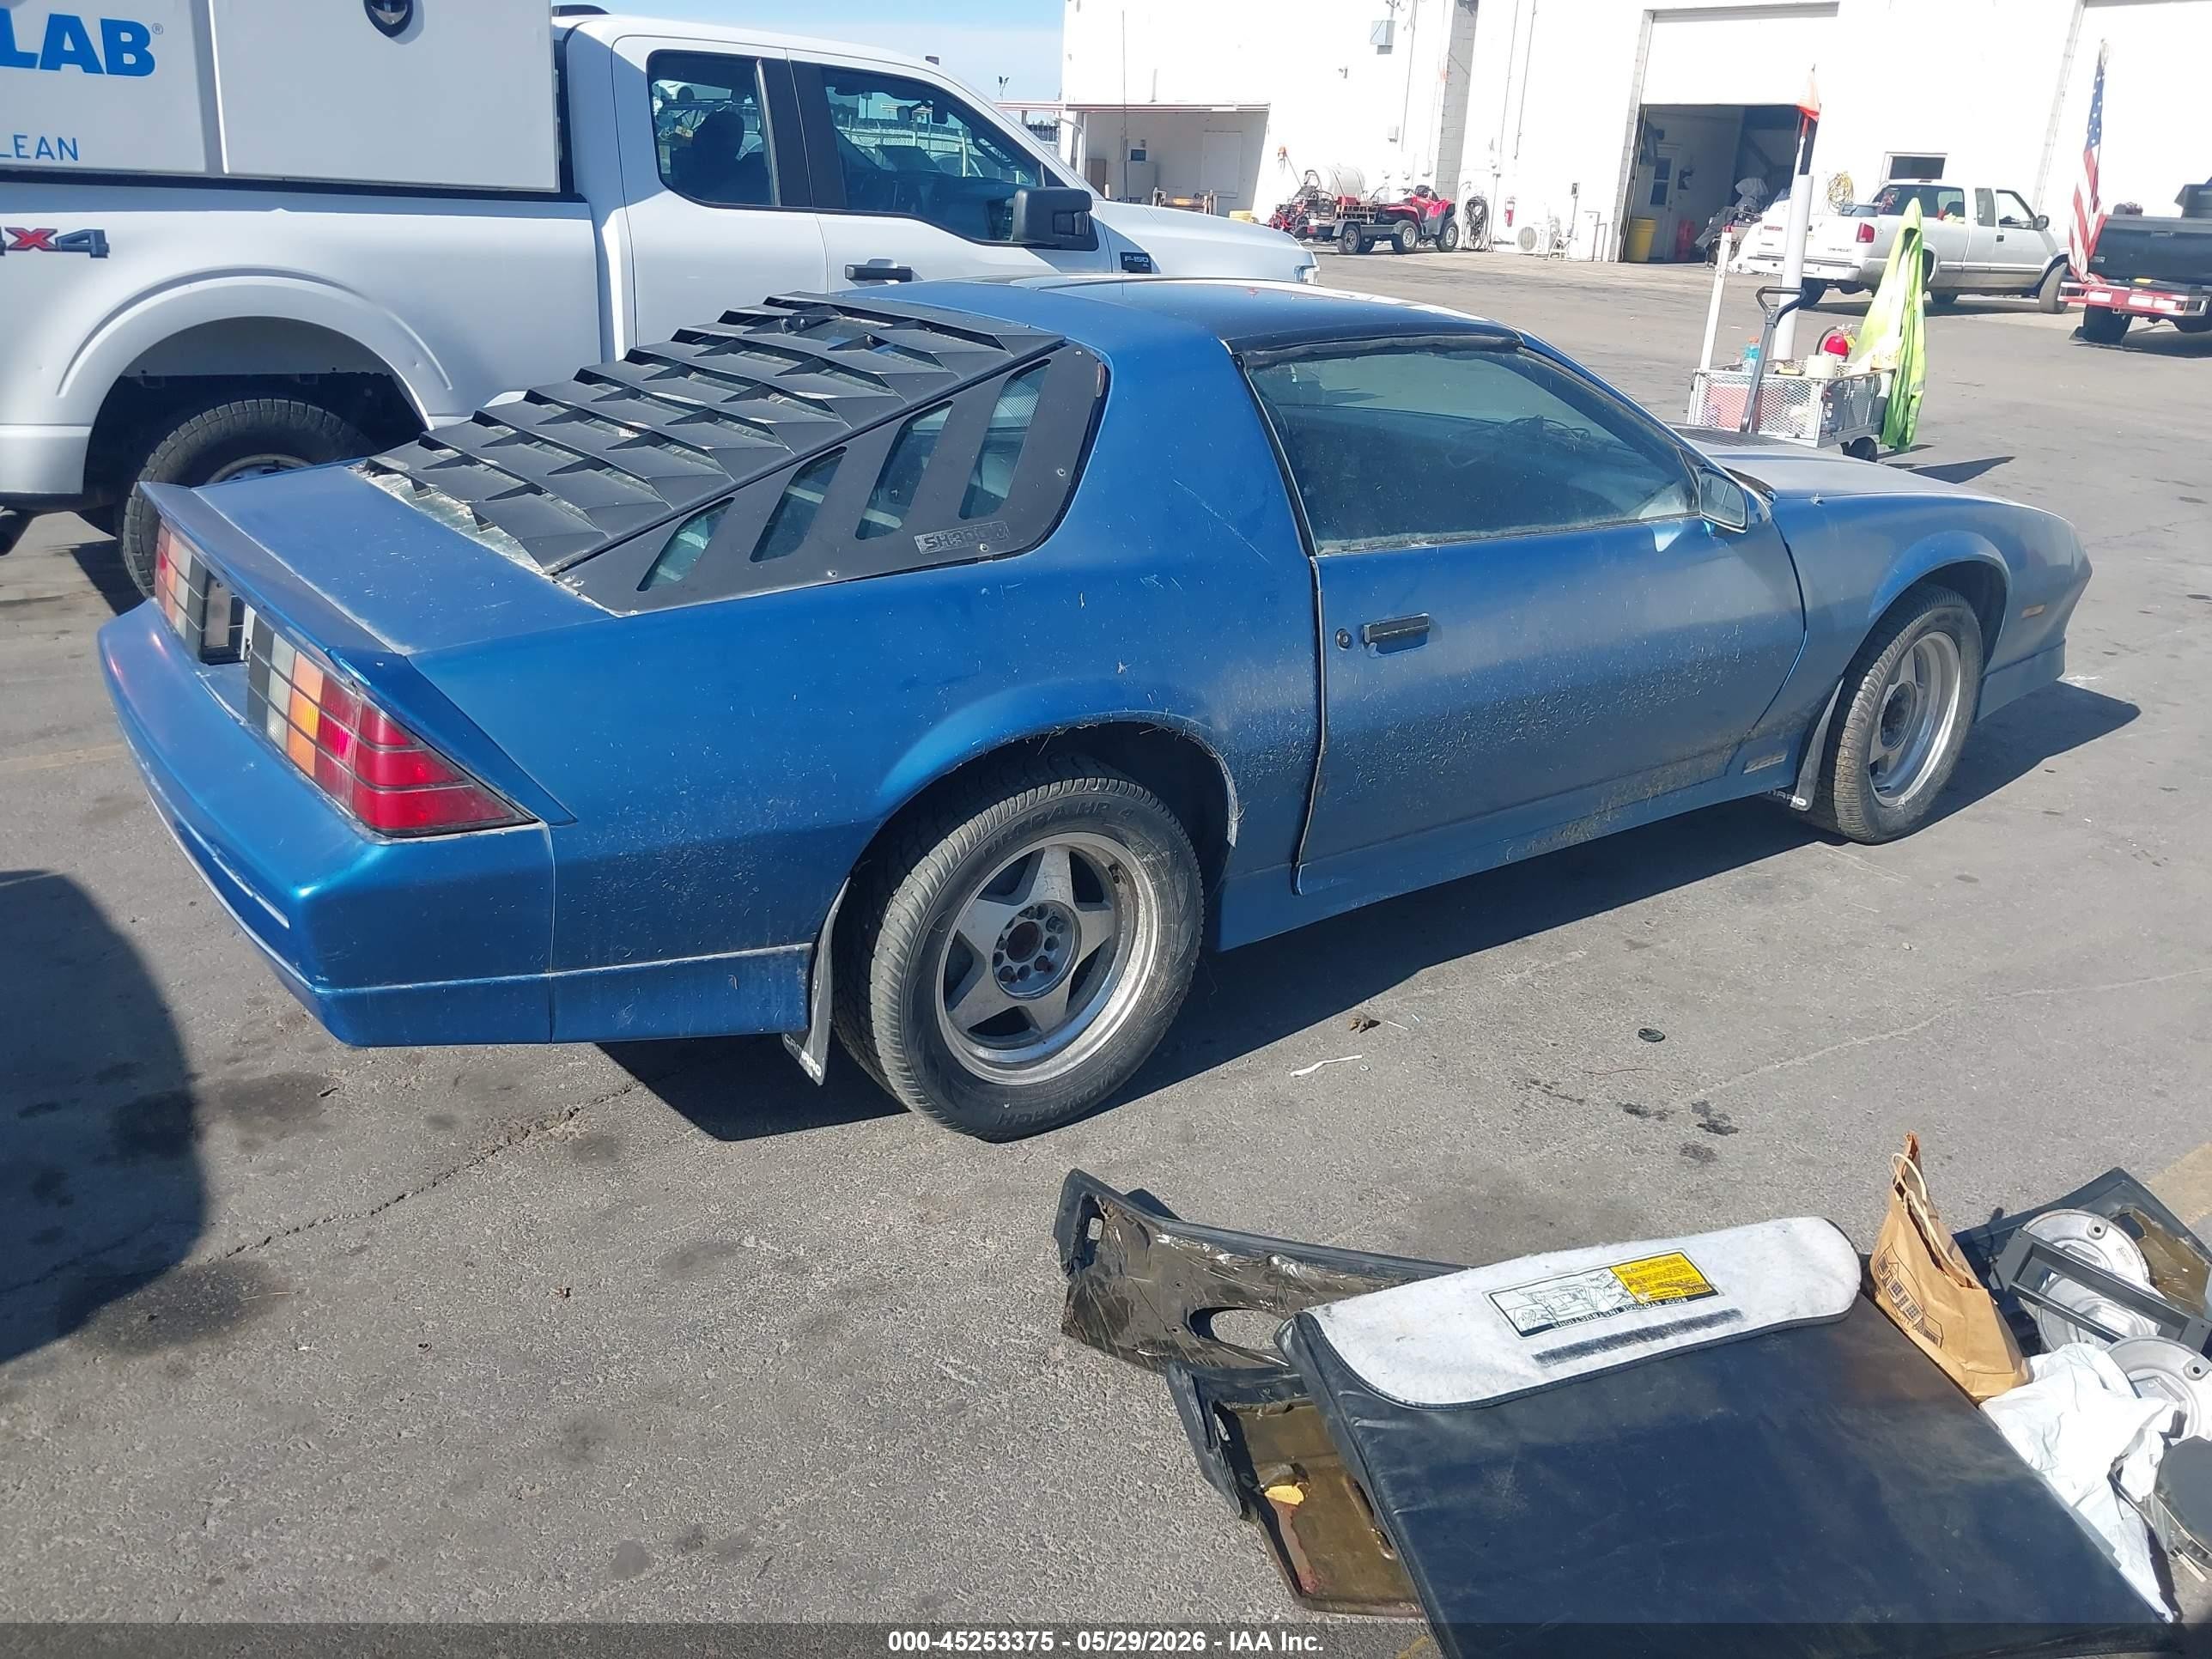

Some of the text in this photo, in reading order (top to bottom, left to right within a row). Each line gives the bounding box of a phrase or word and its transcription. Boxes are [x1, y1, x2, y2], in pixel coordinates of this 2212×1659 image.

[0, 227, 110, 258] X4
[784, 1033, 822, 1077] CAMARO
[1552, 1308, 1620, 1328] INSTRUCTIONS
